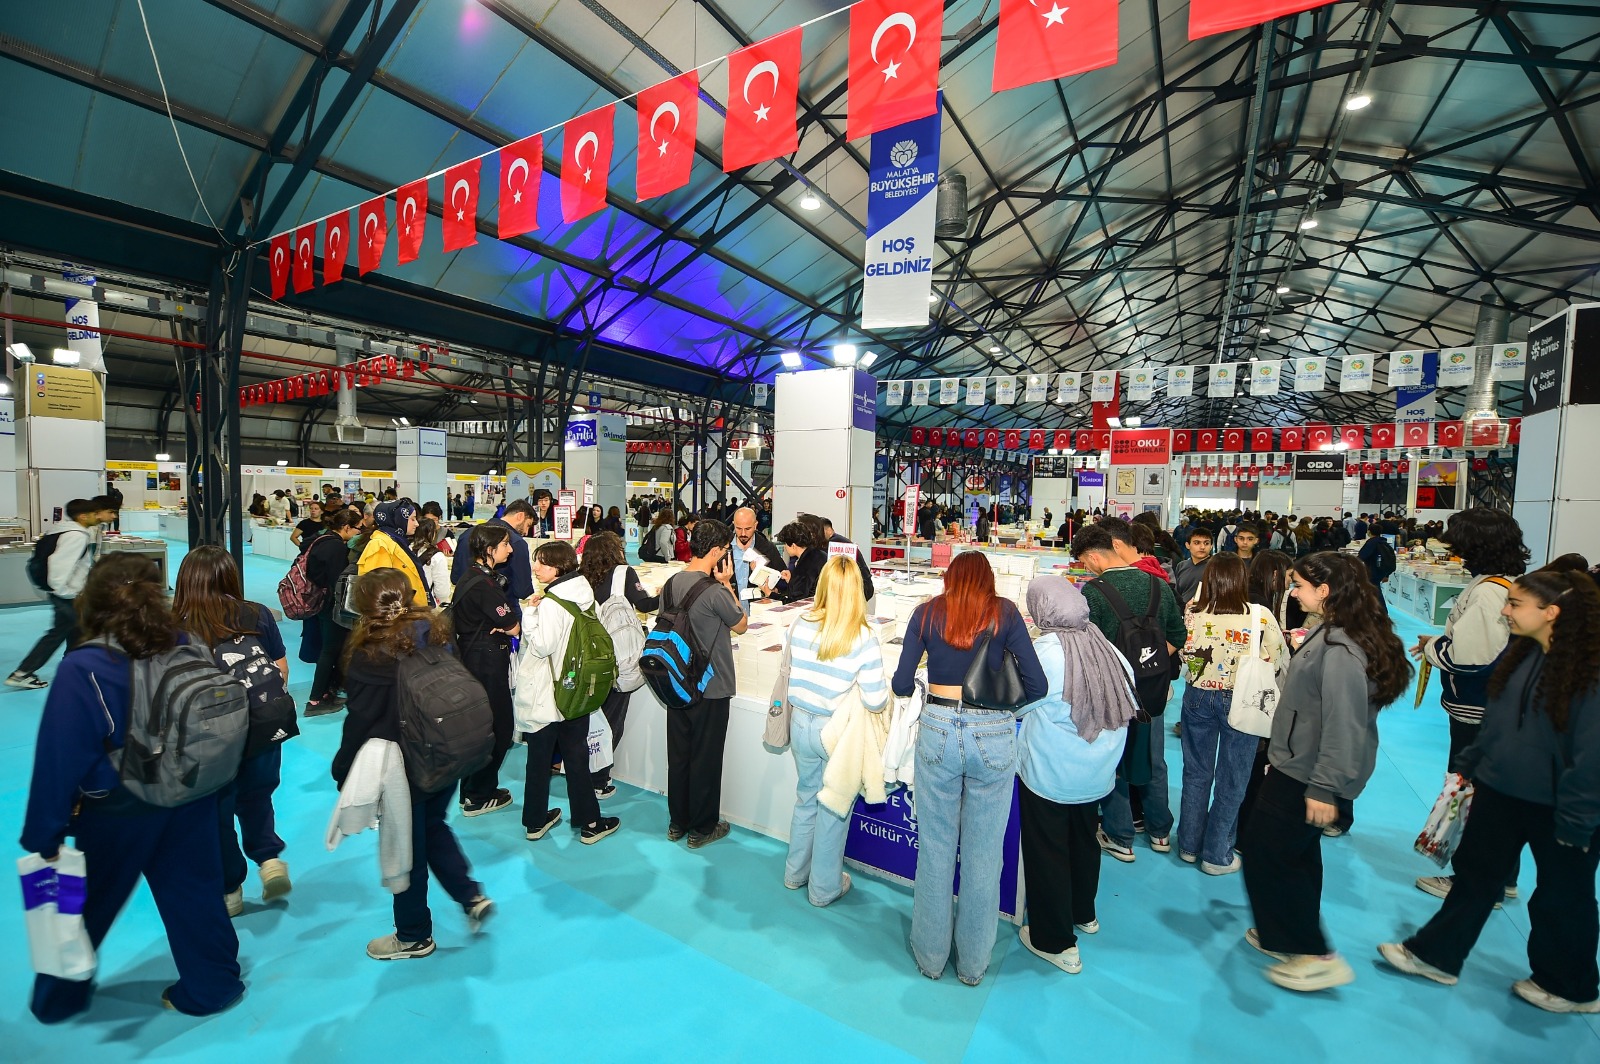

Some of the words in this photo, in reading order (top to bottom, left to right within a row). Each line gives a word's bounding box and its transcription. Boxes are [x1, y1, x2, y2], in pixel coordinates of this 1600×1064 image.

[870, 172, 935, 193] BÜYÜKŞEHİR
[886, 167, 920, 179] MALATYA
[882, 236, 915, 254] HOŞ
[865, 255, 932, 277] GELDİNİZ
[1130, 439, 1166, 448] DOKUZ
[860, 820, 902, 843] Kültür
